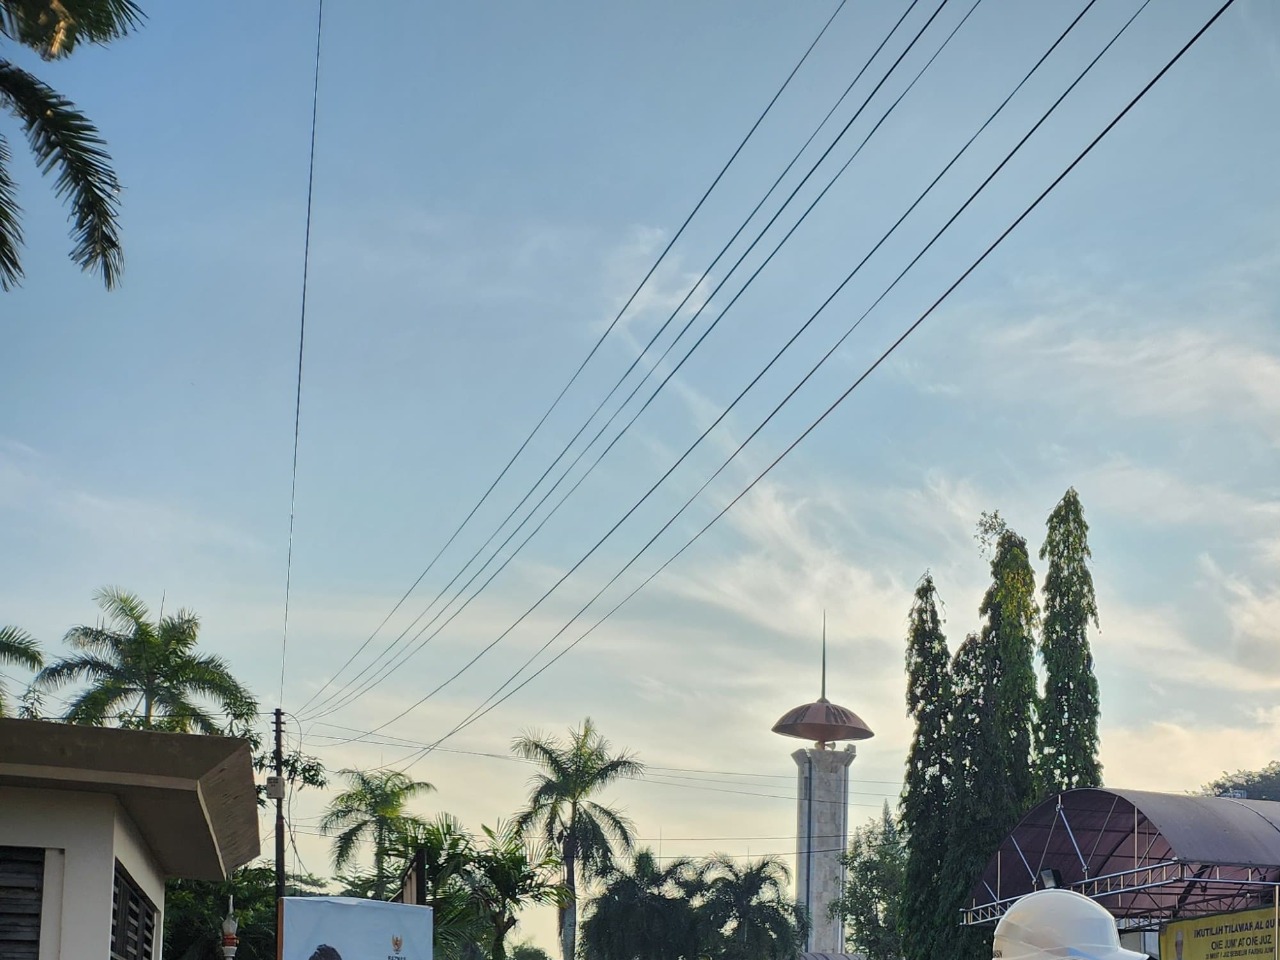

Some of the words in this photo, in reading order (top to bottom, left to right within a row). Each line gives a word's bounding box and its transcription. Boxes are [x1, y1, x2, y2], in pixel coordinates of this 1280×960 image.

[1194, 926, 1223, 938] IKUTILAH
[1255, 921, 1264, 930] AL
[1211, 941, 1223, 950] ONE
[1246, 937, 1258, 946] ONE
[1260, 935, 1272, 944] JUZ
